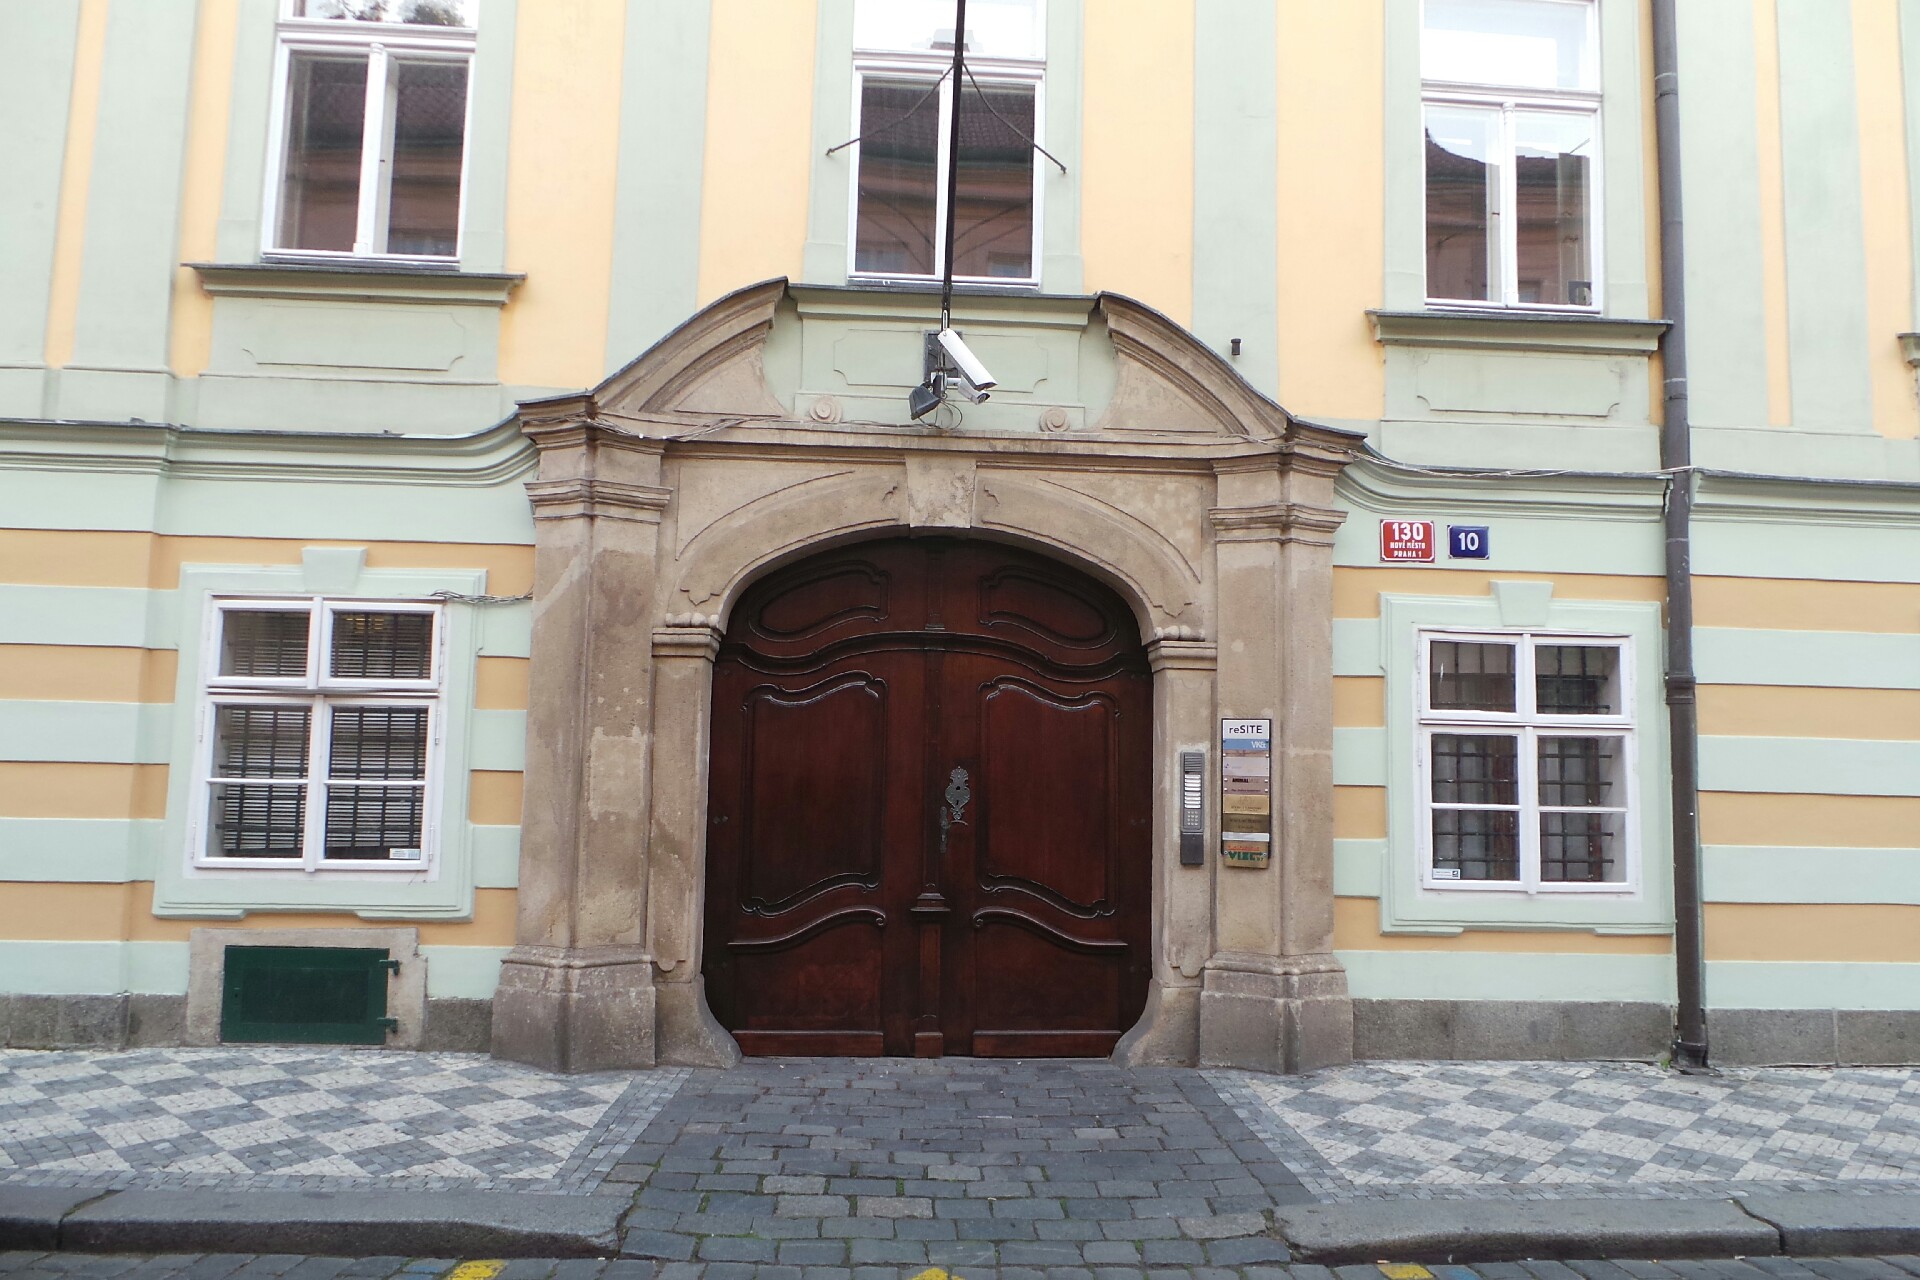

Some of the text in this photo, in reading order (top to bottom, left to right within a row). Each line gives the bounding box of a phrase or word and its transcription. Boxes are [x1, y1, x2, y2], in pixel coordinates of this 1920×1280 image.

[1392, 522, 1424, 541] 130
[1390, 540, 1426, 550] NOVÉ MĚSTO
[1458, 532, 1480, 551] 10
[1393, 550, 1416, 558] PRAHA
[1229, 725, 1263, 734] reSITE
